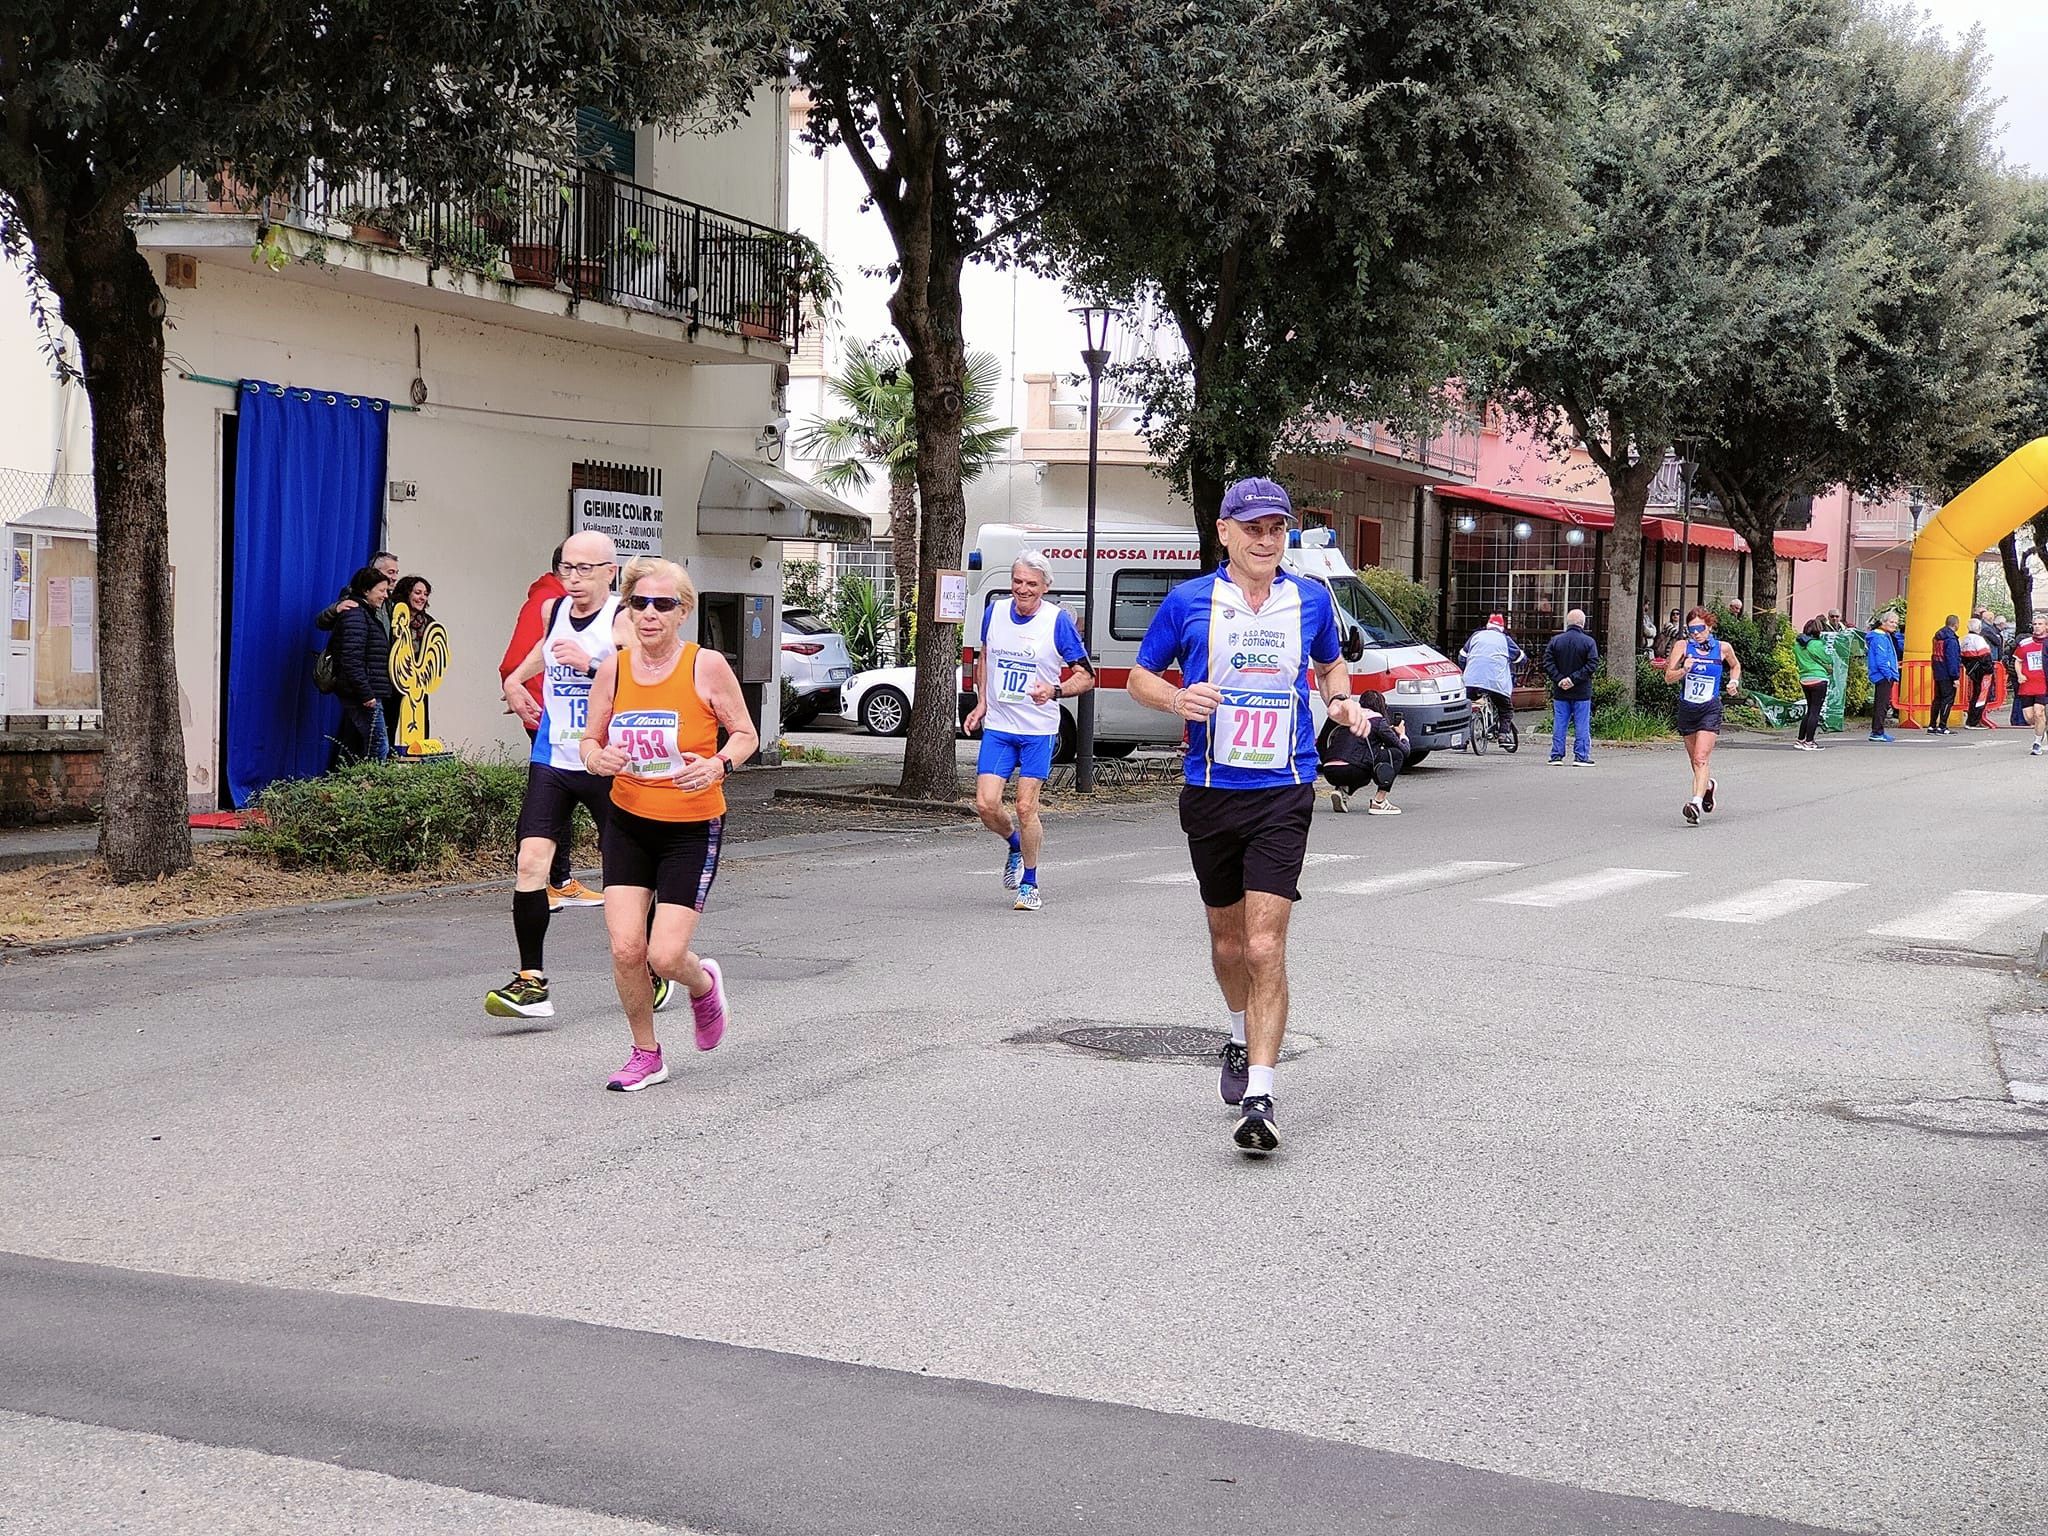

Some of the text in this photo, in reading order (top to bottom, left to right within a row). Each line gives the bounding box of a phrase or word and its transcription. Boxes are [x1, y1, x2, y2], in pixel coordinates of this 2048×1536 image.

[1244, 494, 1283, 503] Champion
[1096, 549, 1147, 560] ROSSA
[1260, 630, 1286, 640] PODISTI
[1242, 638, 1286, 648] COTIGNOLA
[1247, 653, 1279, 664] BCC
[1003, 670, 1028, 693] 102
[1692, 682, 1706, 697] 32
[1232, 709, 1278, 748] 212
[622, 730, 669, 761] 253
